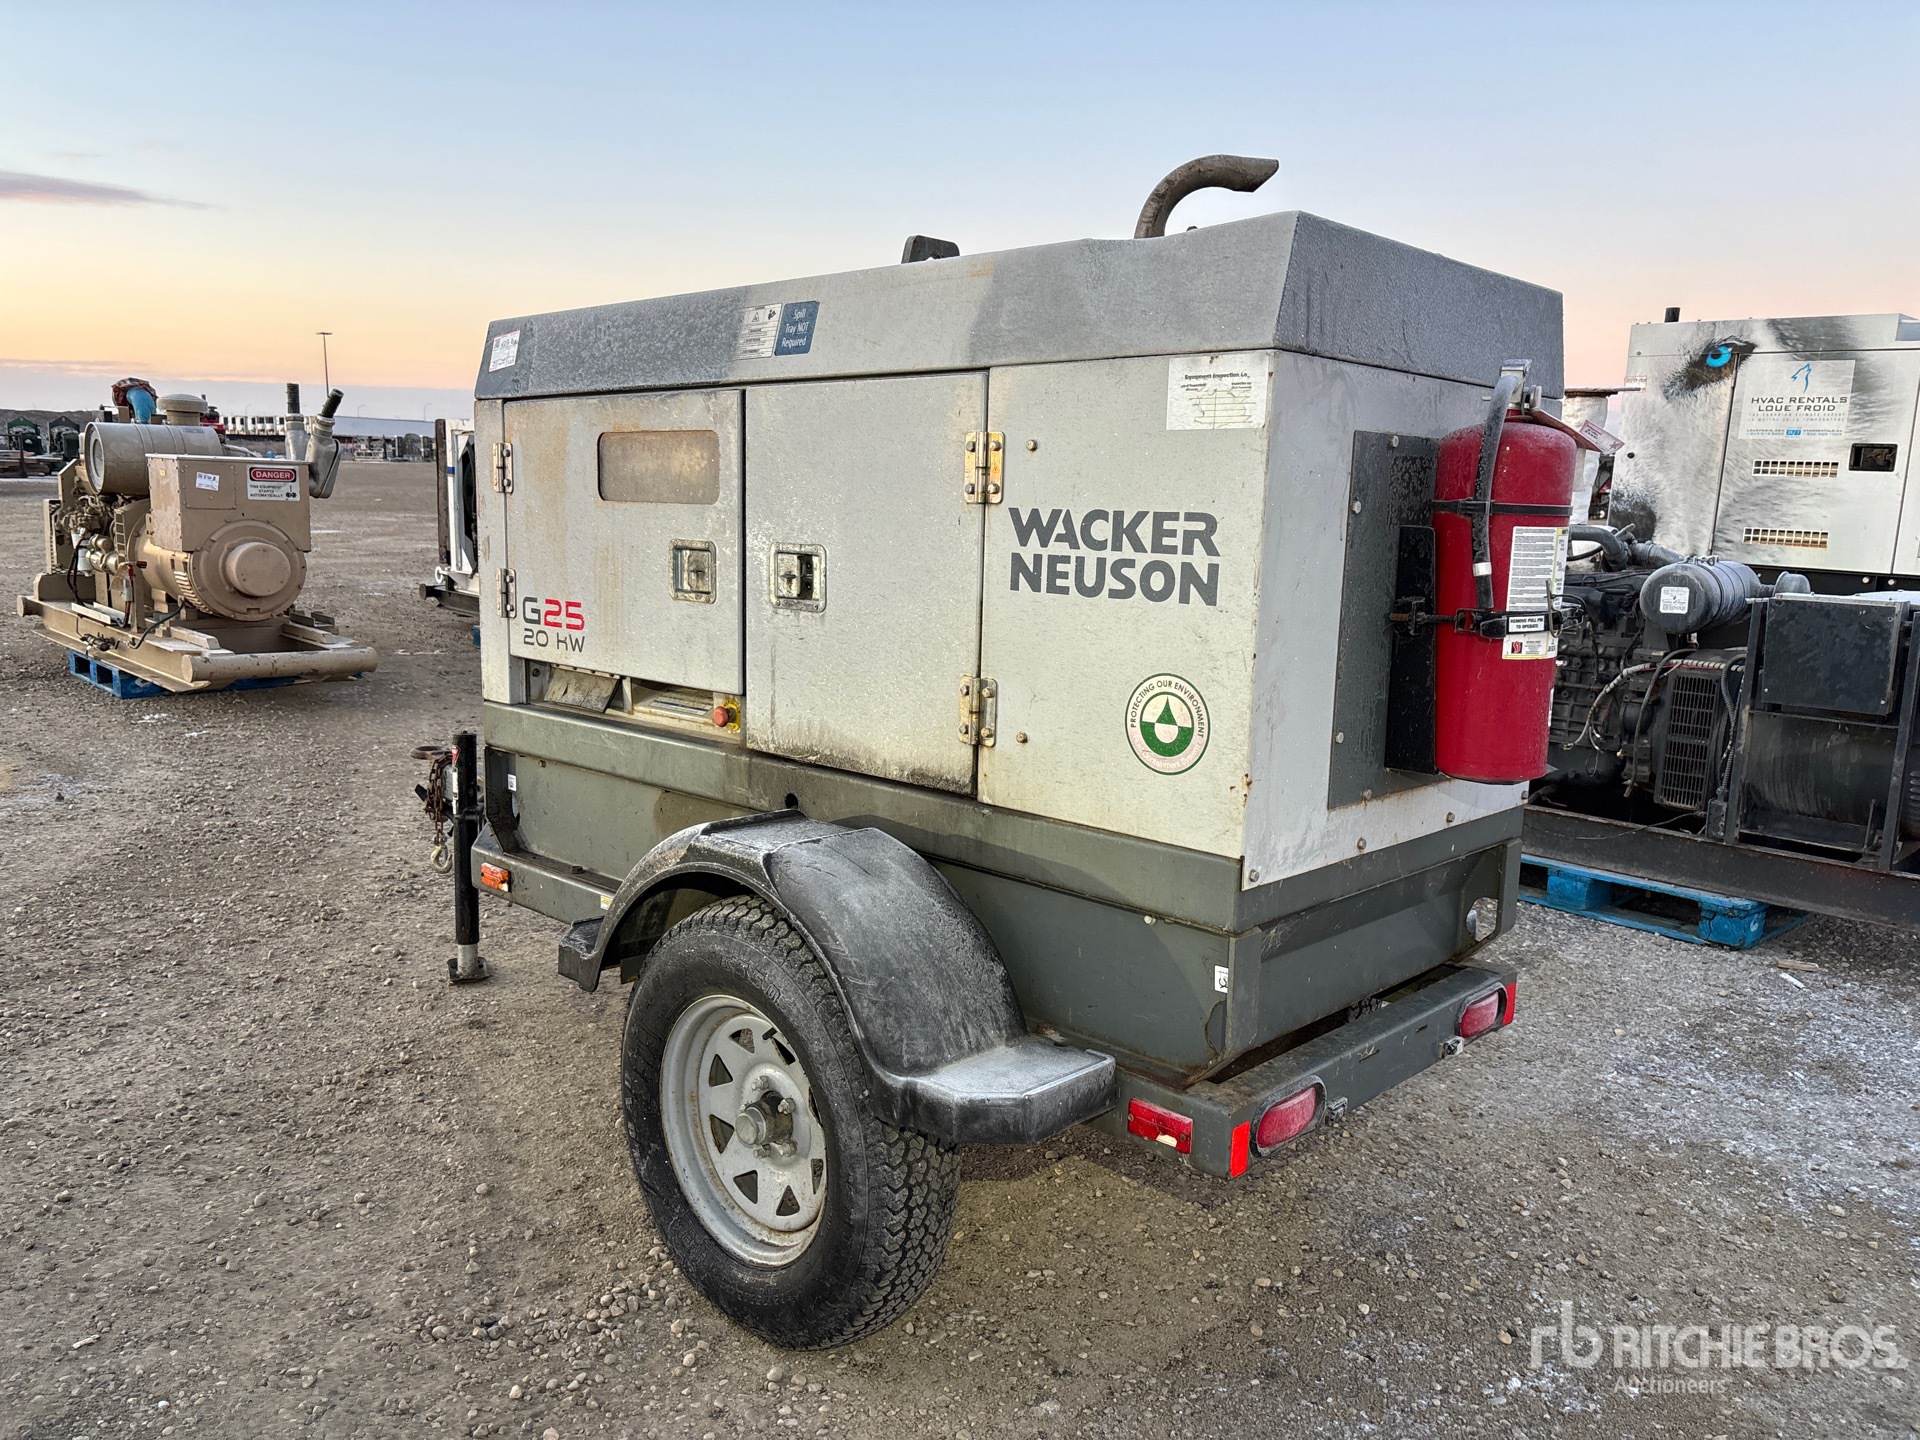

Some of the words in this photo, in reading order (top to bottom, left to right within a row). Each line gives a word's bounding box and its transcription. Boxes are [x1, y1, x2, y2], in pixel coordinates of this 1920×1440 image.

[793, 308, 807, 322] Spill
[785, 323, 798, 336] Tray
[797, 321, 810, 334] NOT
[781, 336, 807, 349] Required
[1751, 396, 1784, 404] HVAC
[1789, 396, 1848, 404] RENTALS
[255, 470, 291, 479] DANGER
[1008, 507, 1221, 557] WACKER
[1009, 552, 1220, 607] NEUSON
[522, 596, 585, 631] G25
[523, 627, 549, 648] 20
[1130, 683, 1155, 728] PROTECTING
[1156, 680, 1173, 688] OUR
[1174, 682, 1205, 738] ENVIRONMENT
